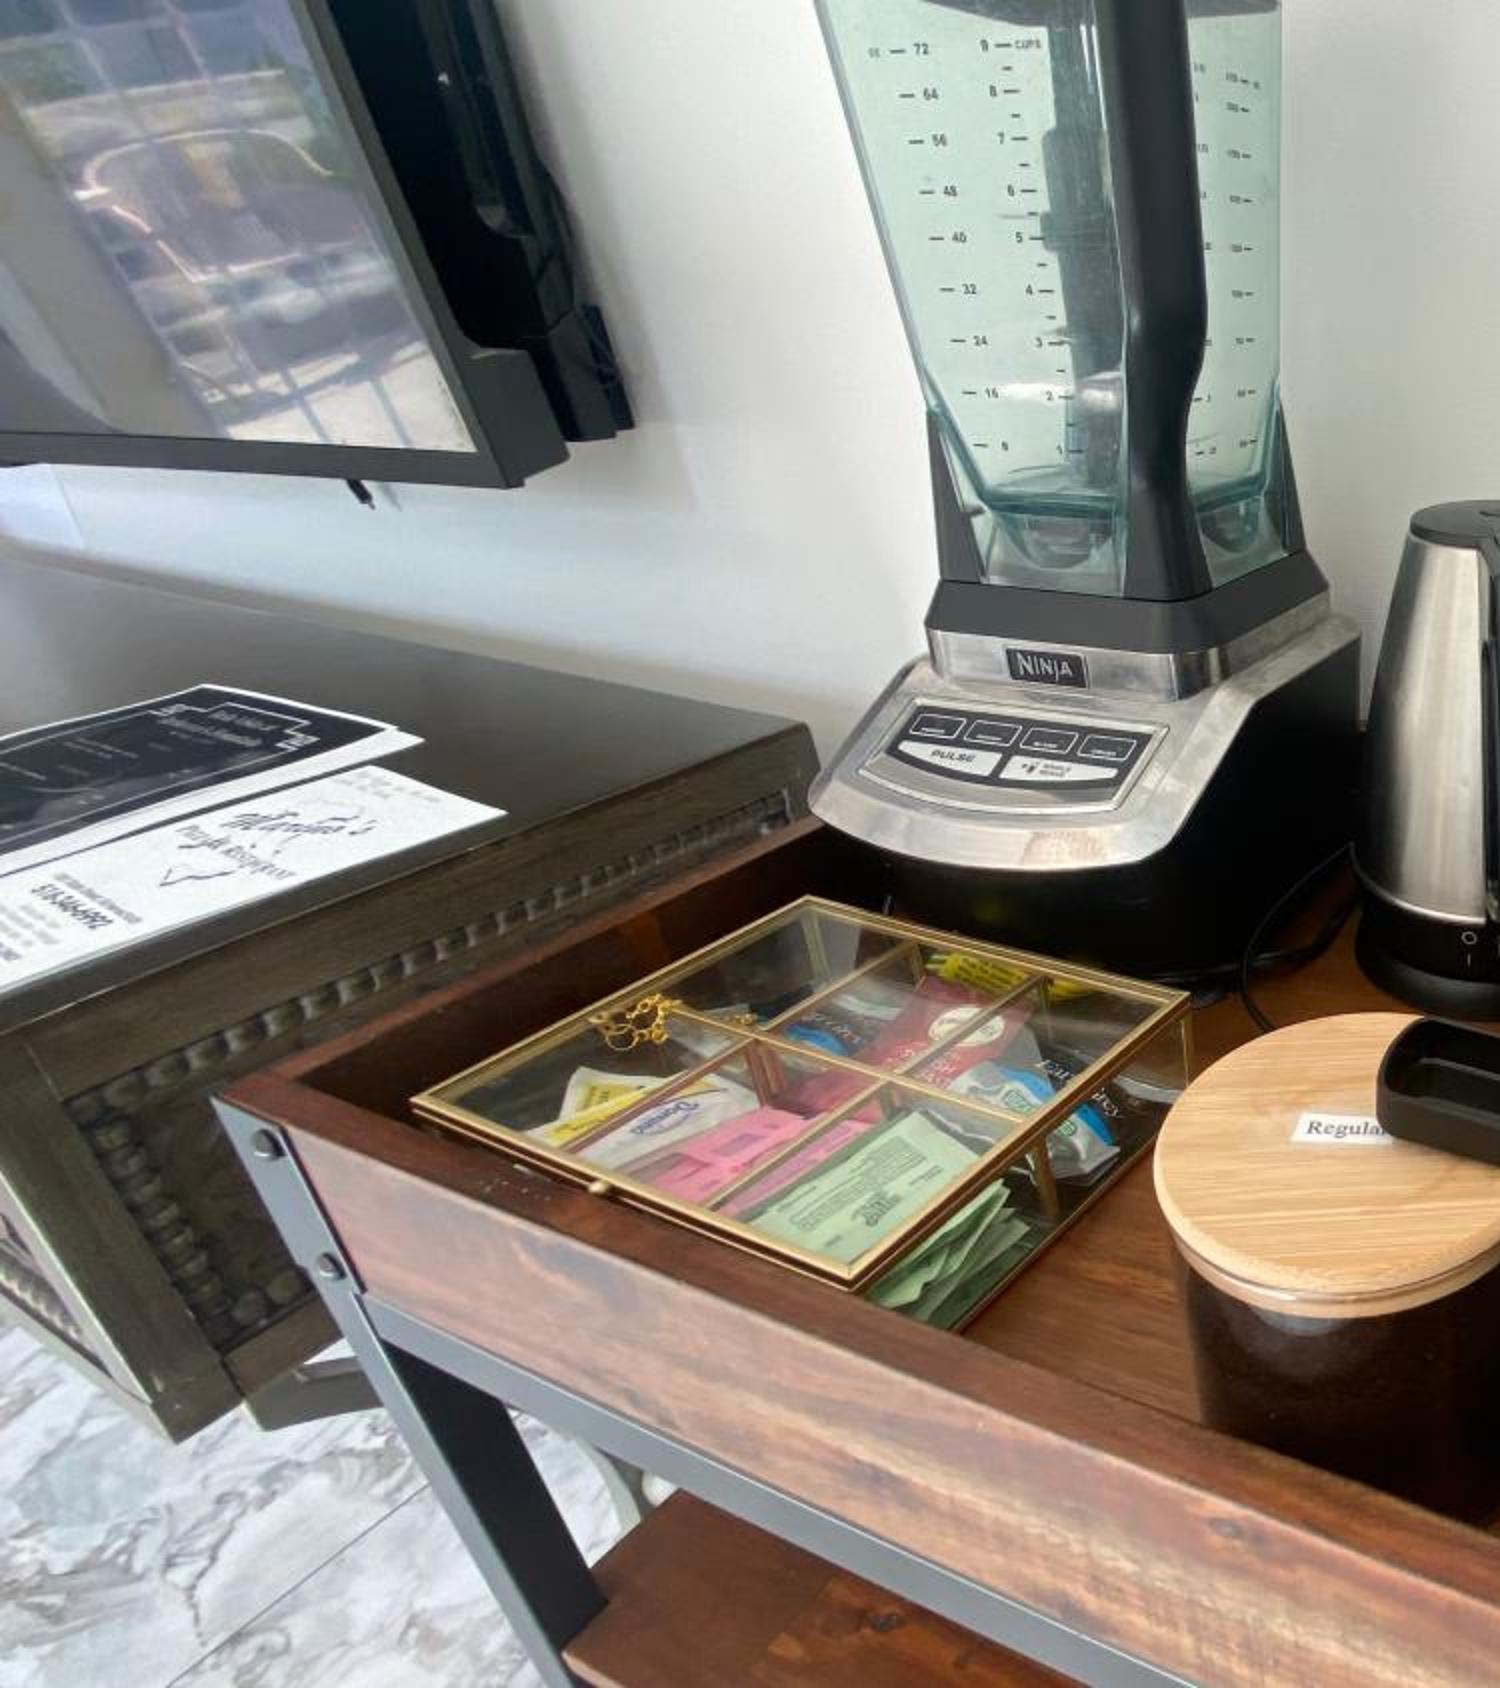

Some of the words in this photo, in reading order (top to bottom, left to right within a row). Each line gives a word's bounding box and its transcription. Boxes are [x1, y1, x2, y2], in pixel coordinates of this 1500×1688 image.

[913, 43, 929, 55] 72
[923, 88, 938, 101] 64
[932, 134, 948, 147] 56
[998, 132, 1005, 145] 7
[943, 185, 958, 197] 48
[952, 231, 967, 243] 40
[1016, 231, 1023, 244] 5
[962, 284, 977, 295] 32
[1026, 284, 1034, 296] 4
[973, 335, 988, 346] 24
[1036, 337, 1043, 348] 3
[1017, 653, 1073, 683] NINJA
[931, 750, 975, 763] PULSE
